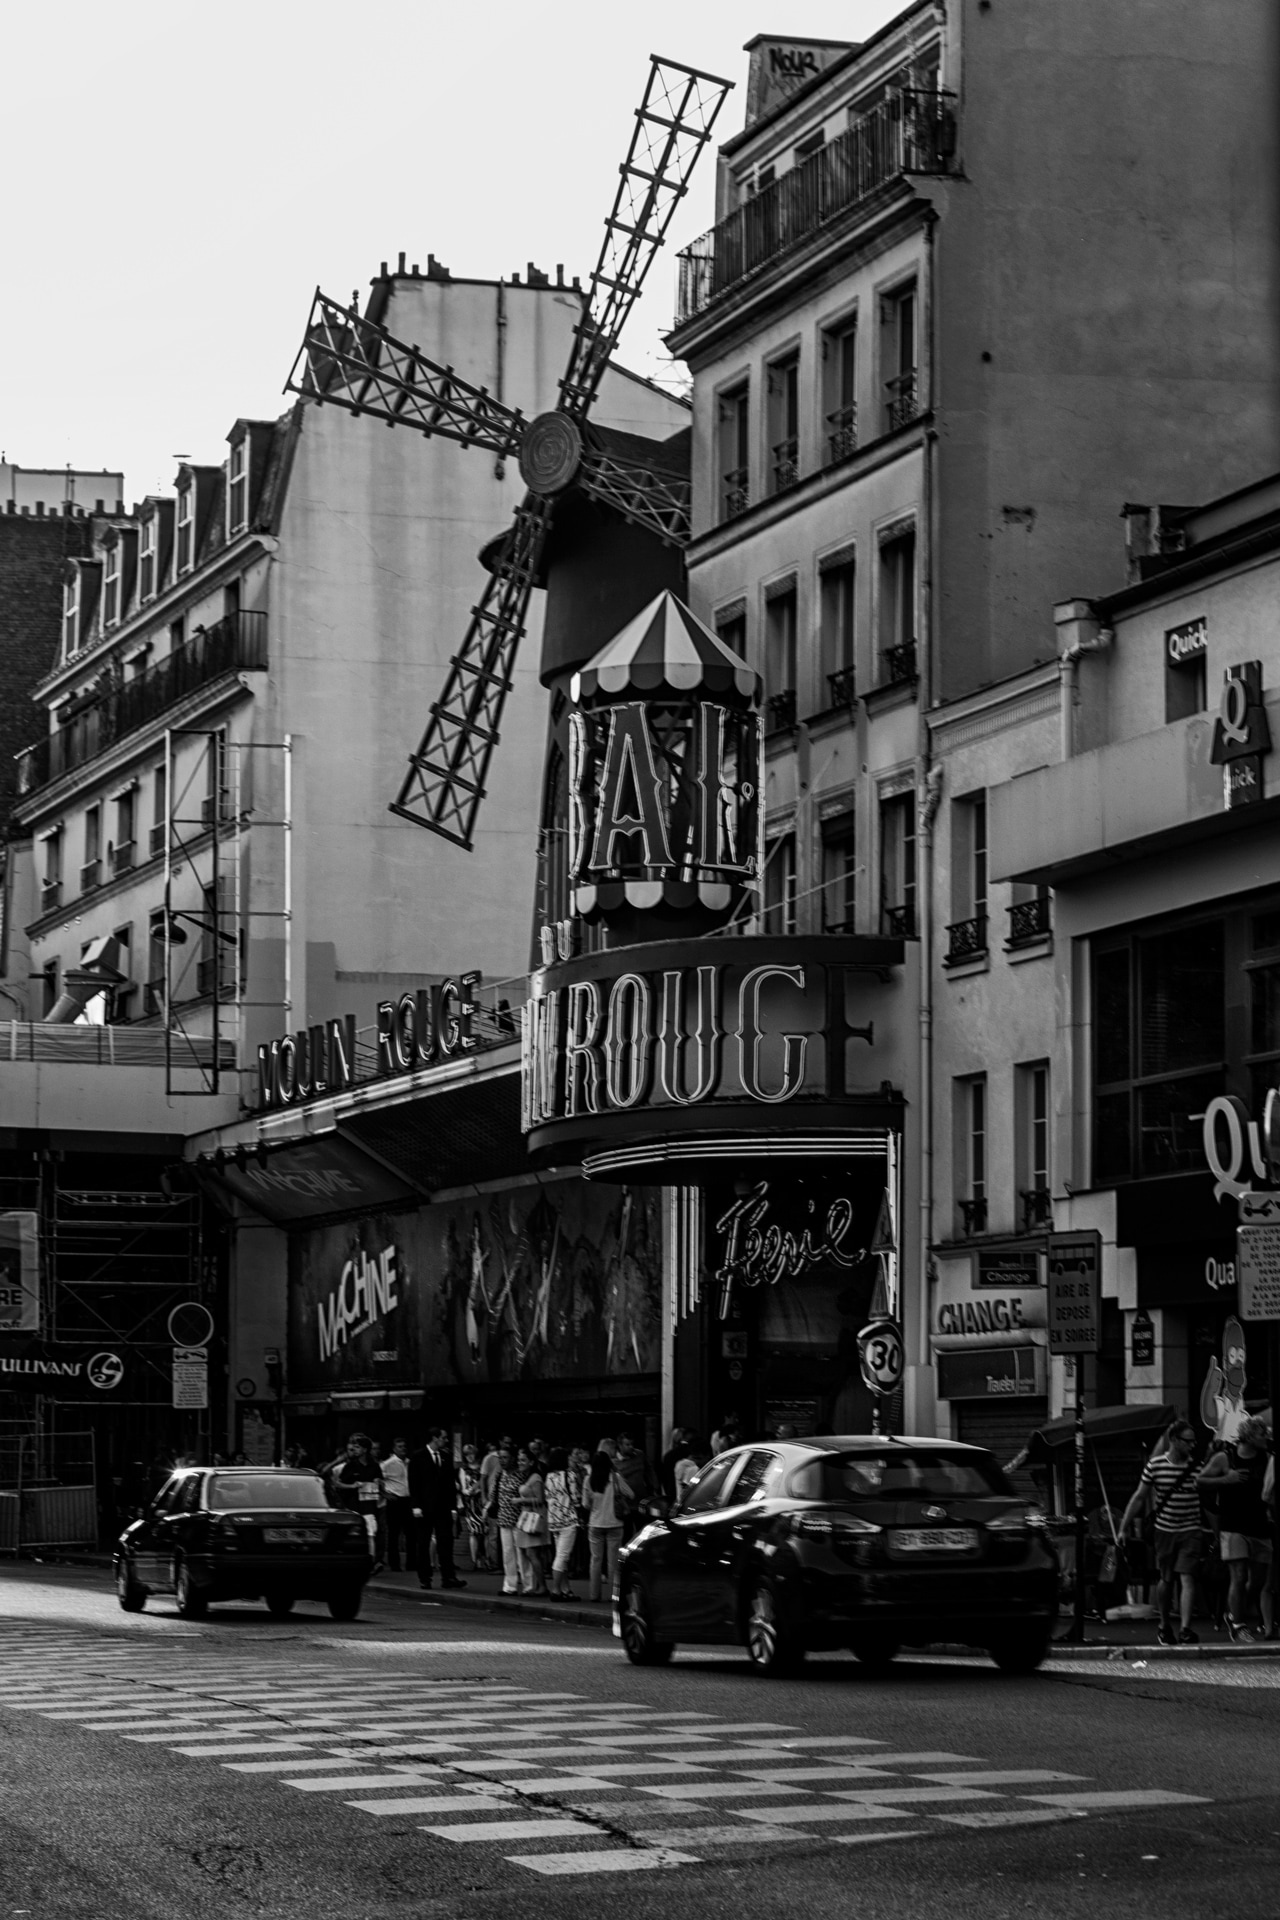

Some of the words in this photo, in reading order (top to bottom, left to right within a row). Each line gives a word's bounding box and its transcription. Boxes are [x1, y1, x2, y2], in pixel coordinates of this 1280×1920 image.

[1169, 622, 1208, 661] Quick
[376, 970, 481, 1070] ROUGE
[564, 962, 899, 1118] ROUGE
[985, 1271, 1031, 1284] Change
[1055, 1284, 1075, 1298] AIRE
[1079, 1282, 1090, 1297] DE
[317, 1244, 398, 1362] MACHINE
[939, 1297, 1022, 1335] CHANGE
[1055, 1305, 1091, 1321] DEPOSE
[1050, 1328, 1062, 1344] EN
[870, 1340, 899, 1374] 30
